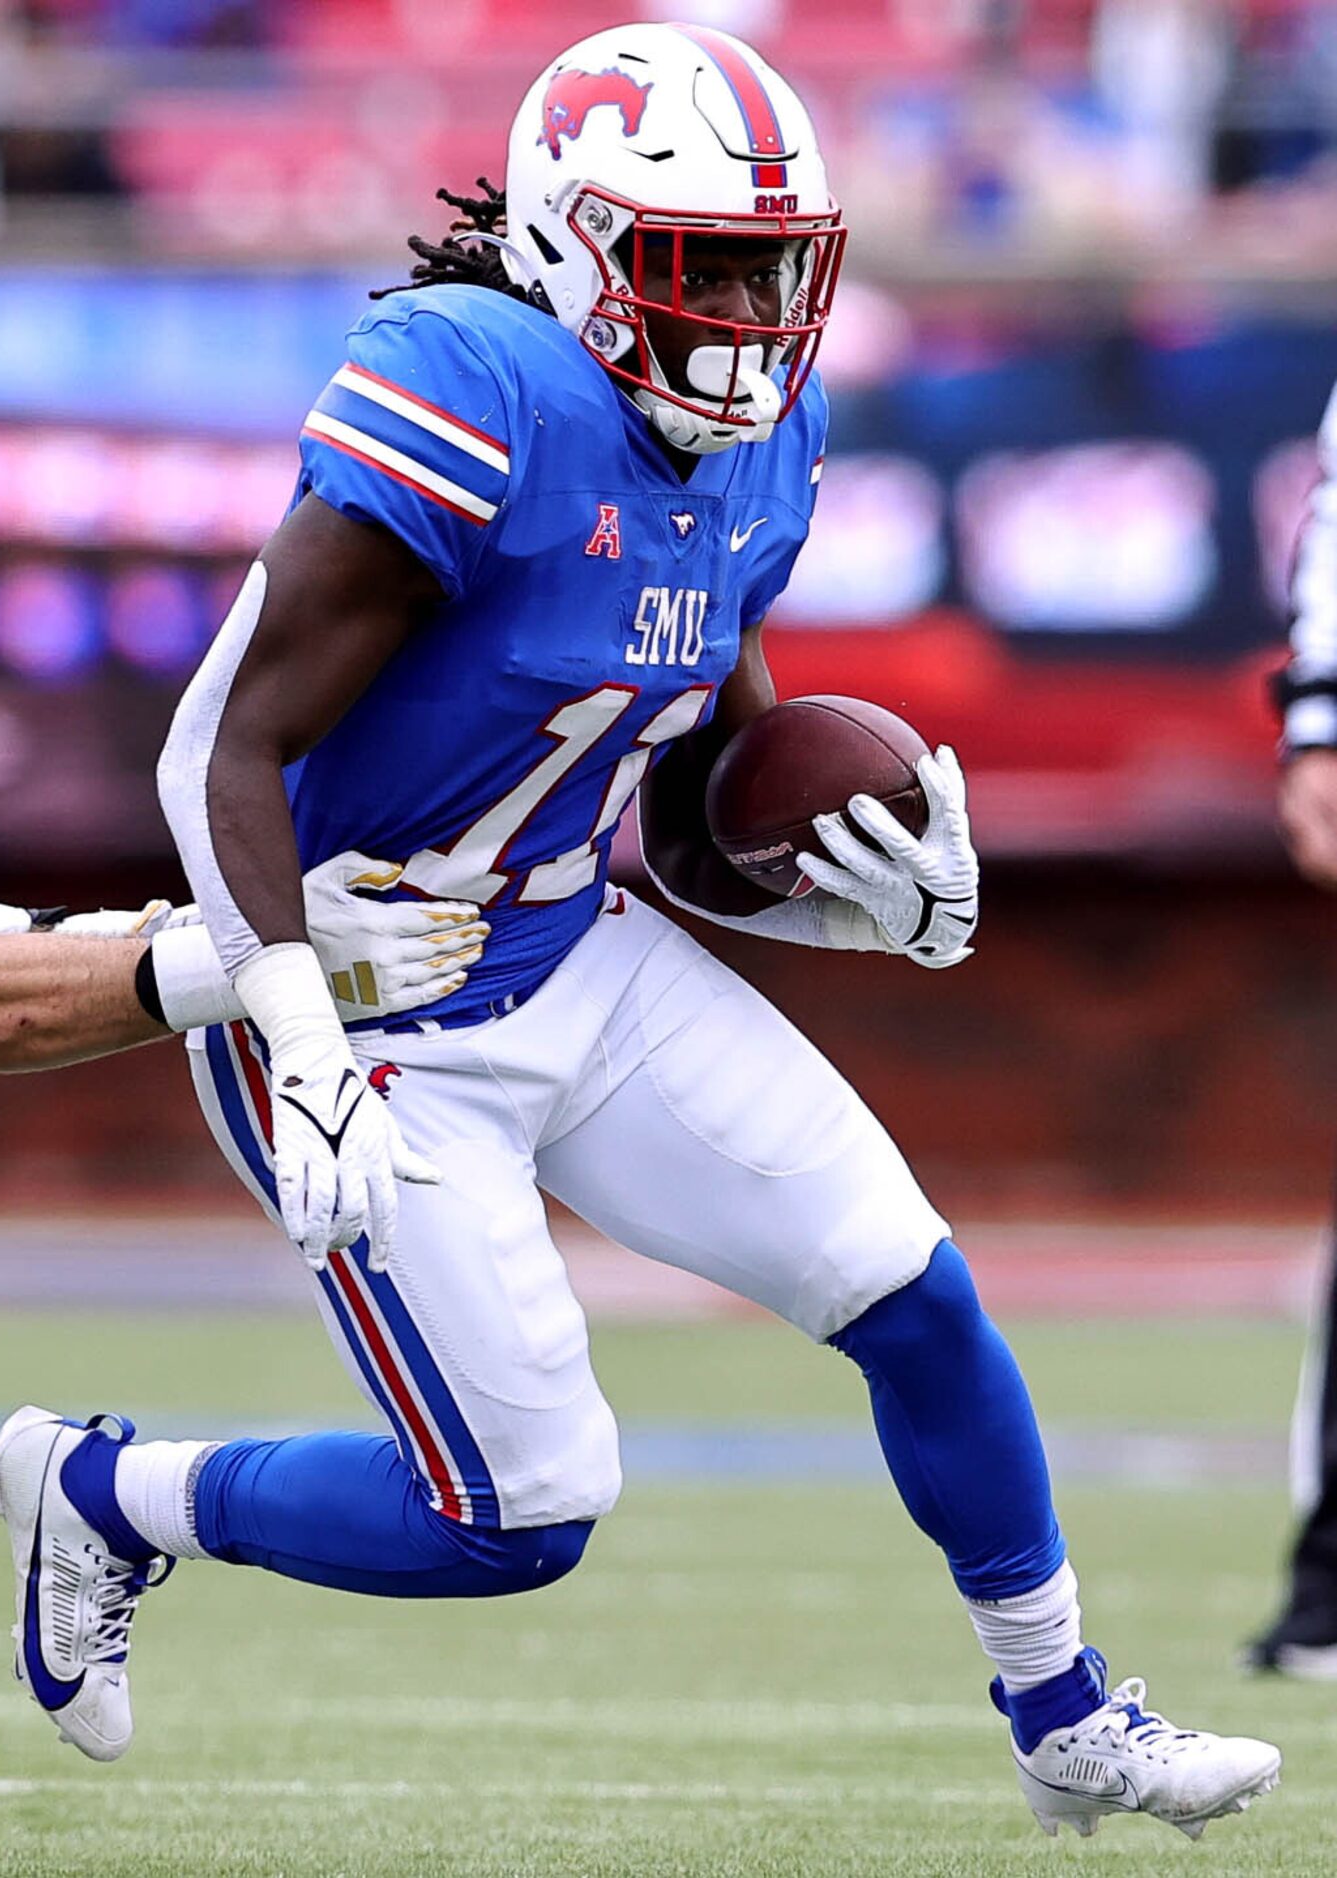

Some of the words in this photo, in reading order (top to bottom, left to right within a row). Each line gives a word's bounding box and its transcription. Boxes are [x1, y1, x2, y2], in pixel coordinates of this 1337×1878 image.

[754, 194, 798, 214] SMU
[775, 287, 809, 348] Rddell
[625, 586, 708, 667] SMU
[400, 681, 715, 907] 11
